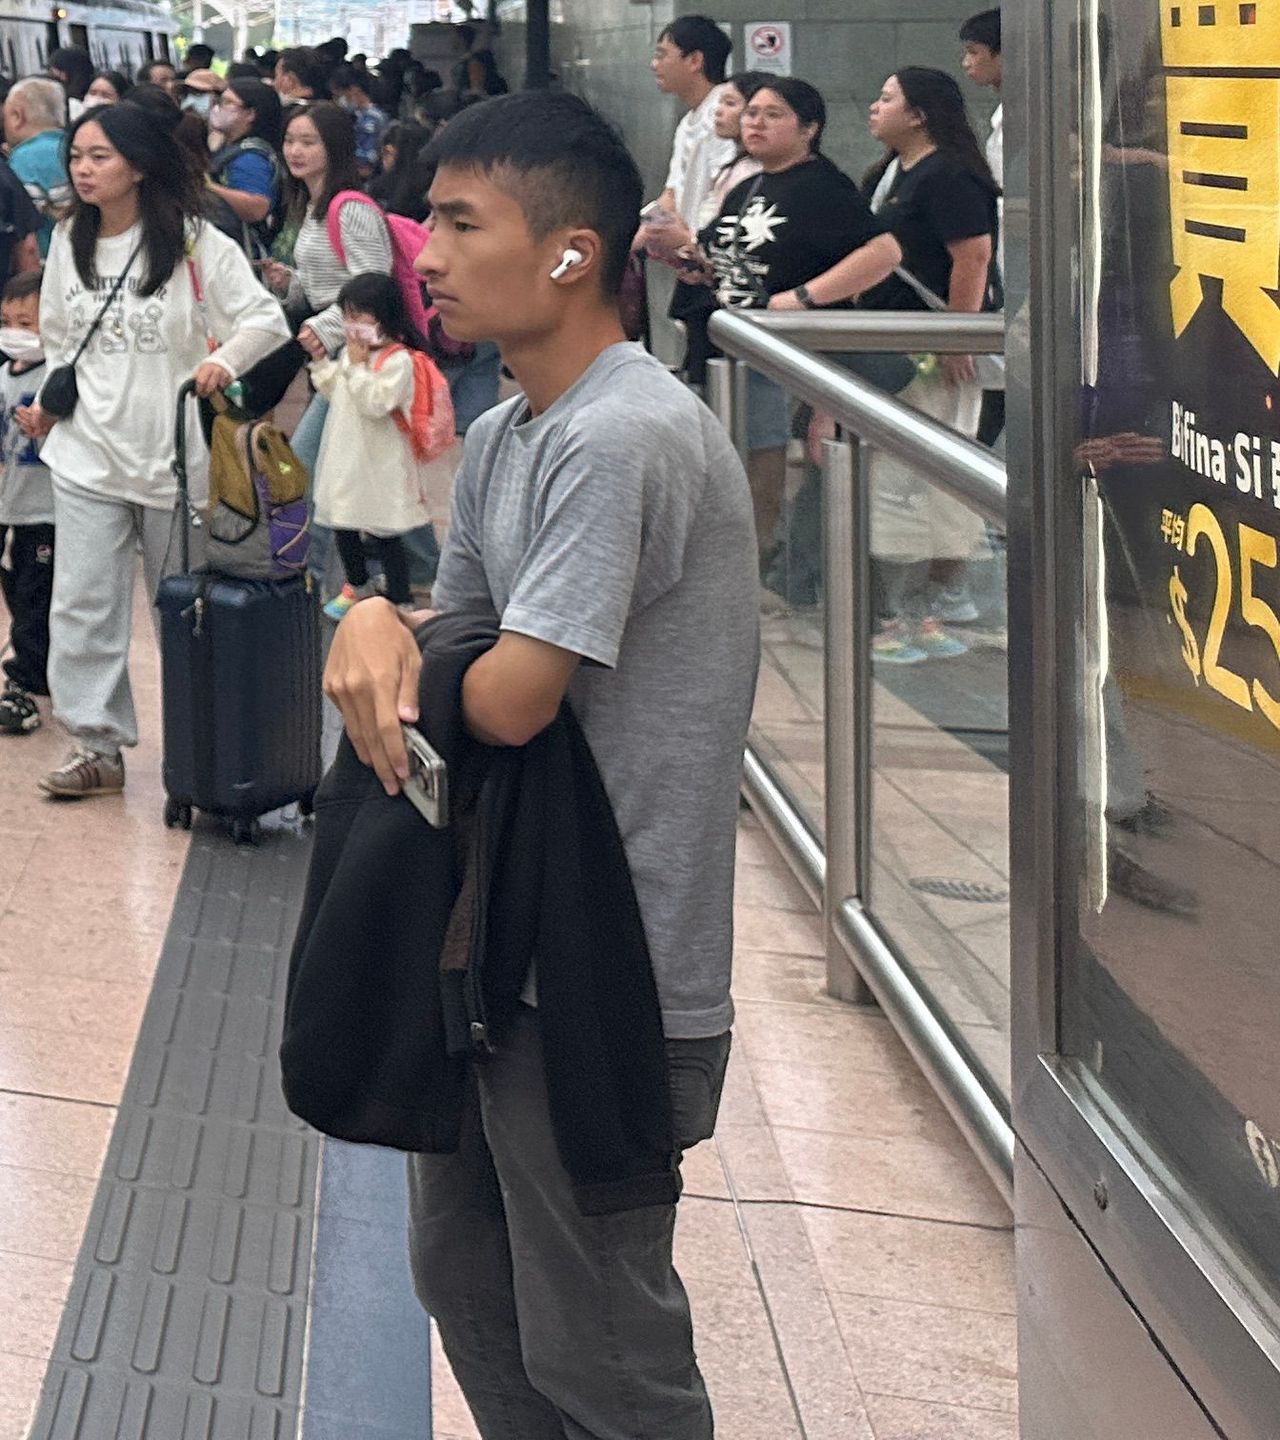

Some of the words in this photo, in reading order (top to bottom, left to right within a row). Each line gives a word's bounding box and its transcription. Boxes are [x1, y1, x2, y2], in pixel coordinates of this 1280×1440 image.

[1171, 400, 1227, 485] Bifina
[1233, 431, 1264, 500] Si
[1161, 508, 1185, 552] 平均
